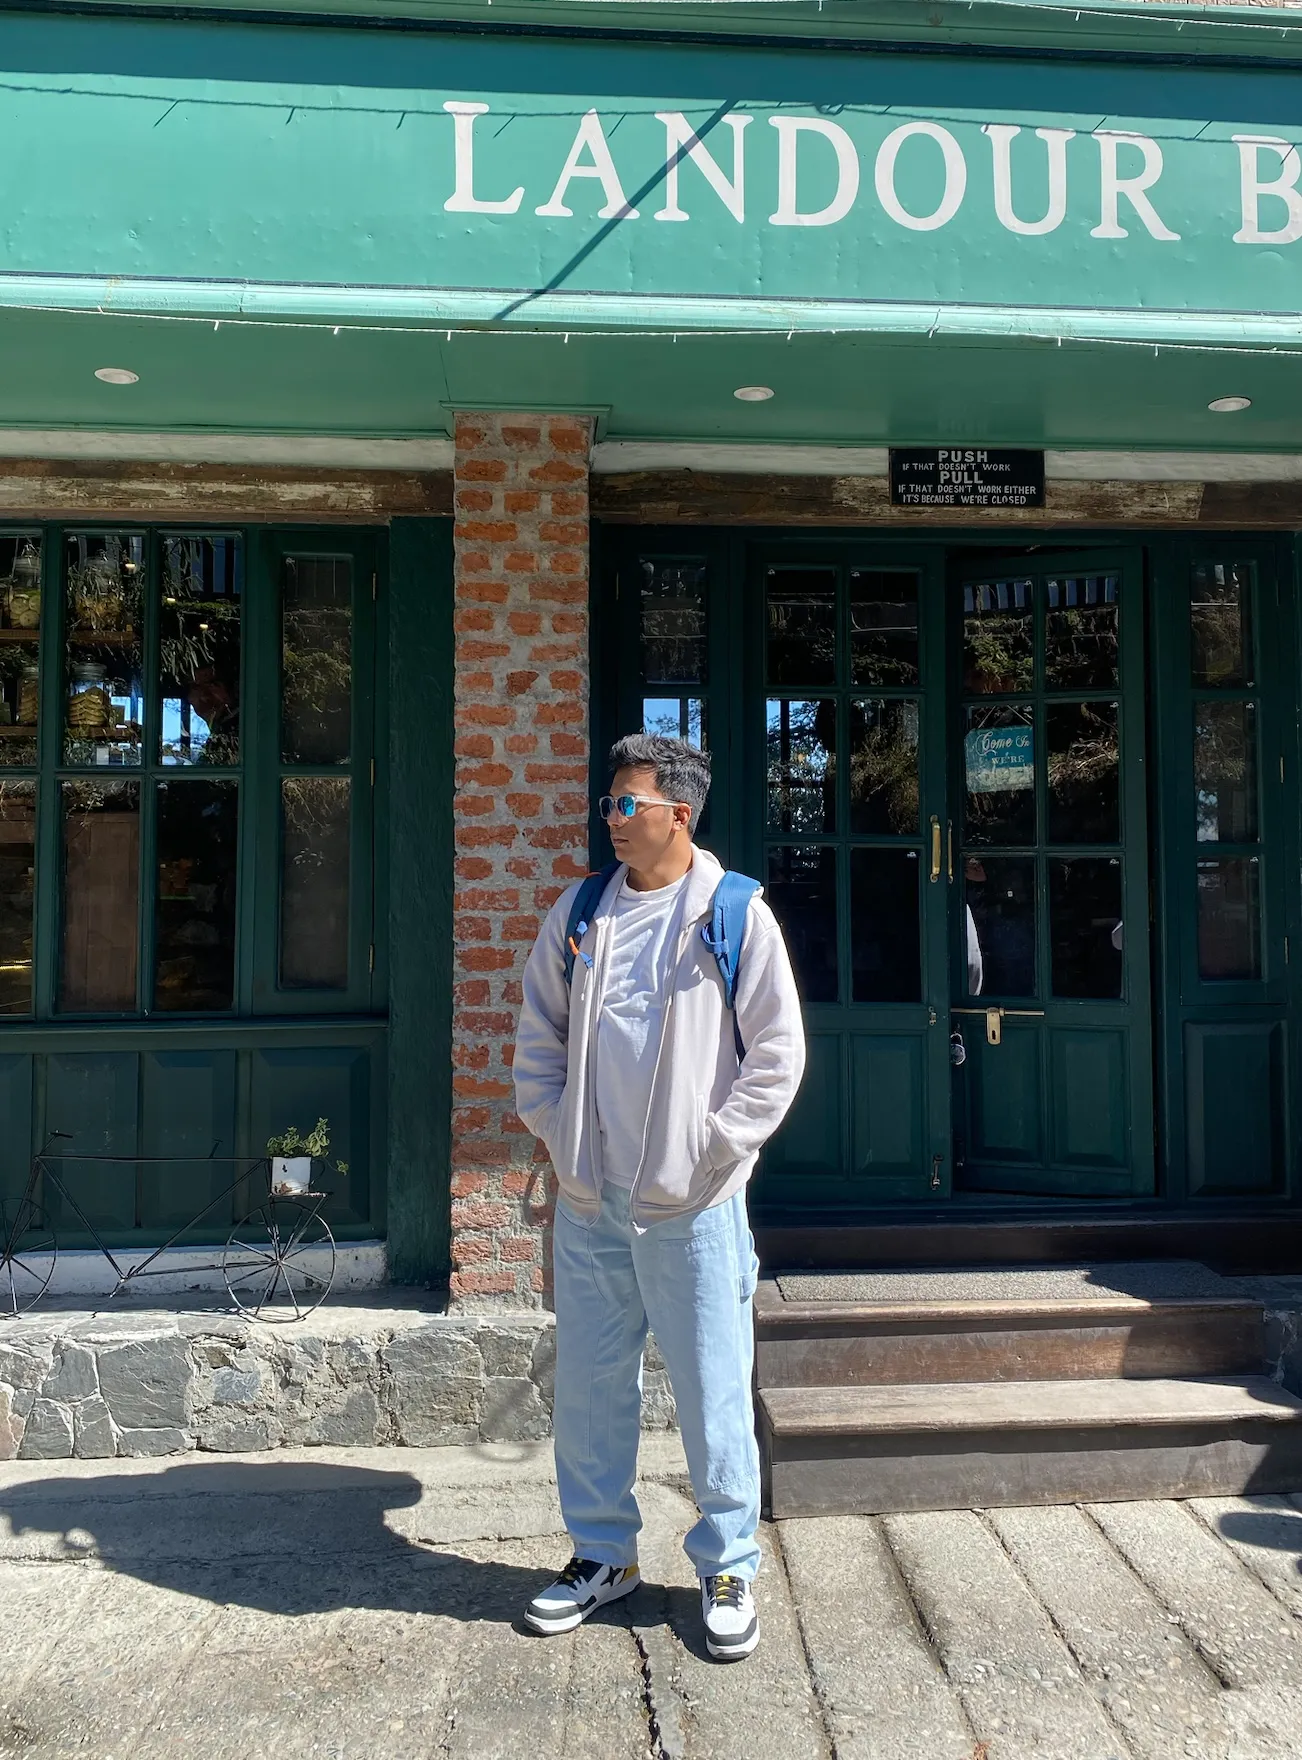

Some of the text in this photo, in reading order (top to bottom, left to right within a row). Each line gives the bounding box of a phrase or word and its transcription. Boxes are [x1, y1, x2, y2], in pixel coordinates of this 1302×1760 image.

[442, 100, 1181, 242] LANDOUR
[938, 450, 988, 463] PUSH
[902, 463, 1011, 472] IF THAT DOESN'T WORK
[939, 471, 984, 484] PULL
[898, 484, 1037, 495] IF THAT DOESN'T WORK EITHER
[902, 494, 1027, 505] IT'S BECAUSE WE'RE CLOSED
[975, 731, 1031, 757] Come In
[991, 754, 1025, 765] WE'RE
